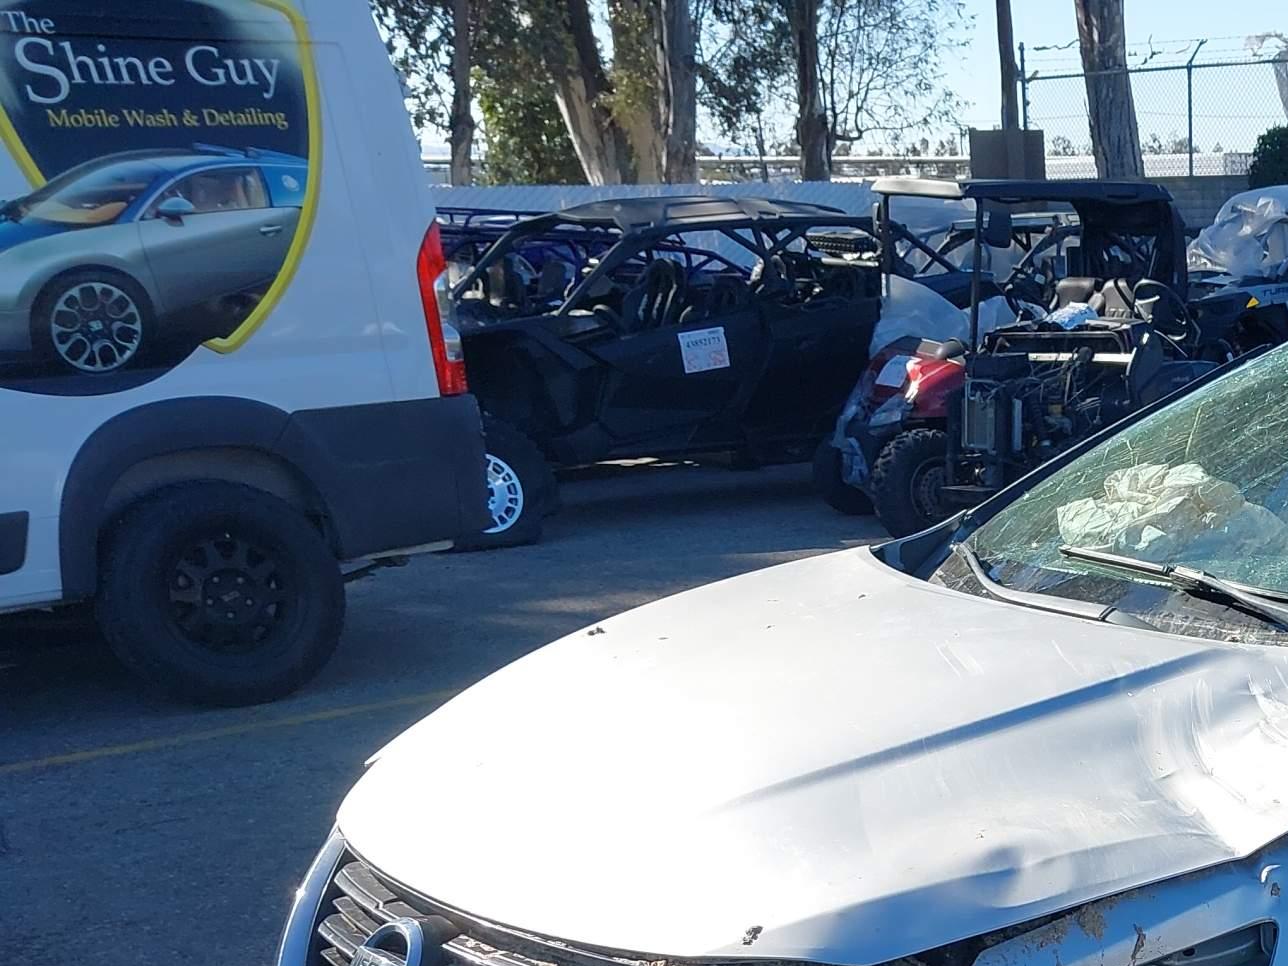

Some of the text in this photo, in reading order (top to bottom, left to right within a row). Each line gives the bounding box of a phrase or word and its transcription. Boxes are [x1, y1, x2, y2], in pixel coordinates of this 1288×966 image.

[1, 10, 56, 34] The
[14, 36, 280, 104] Shine Guy
[45, 108, 289, 130] Mobile Wash & Detailing
